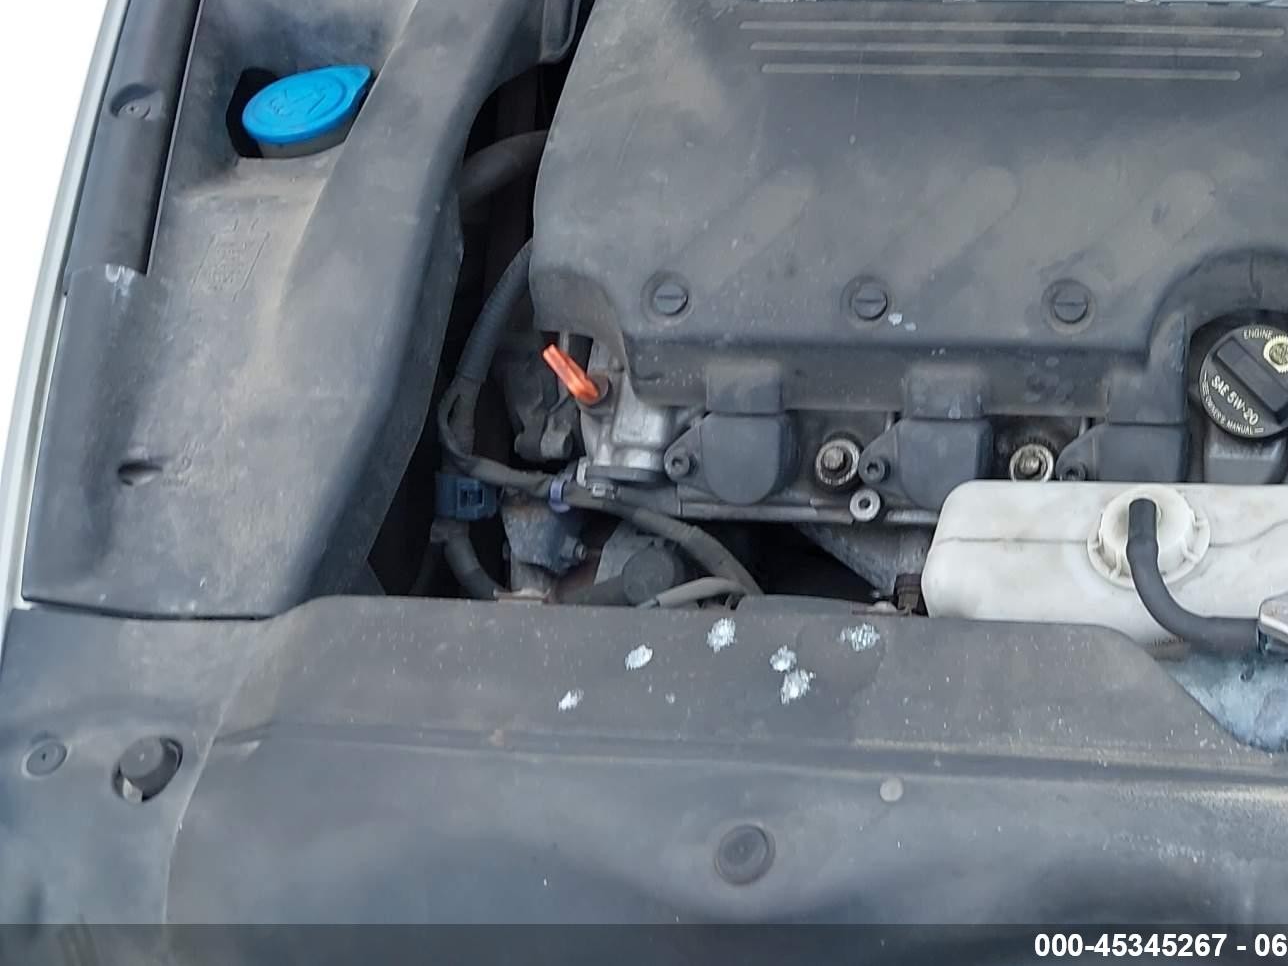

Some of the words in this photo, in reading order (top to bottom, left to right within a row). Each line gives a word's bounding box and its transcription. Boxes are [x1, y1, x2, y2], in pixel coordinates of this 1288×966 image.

[1243, 328, 1274, 340] ENGINE
[1211, 375, 1231, 397] SAE
[1227, 391, 1260, 426] 5W-20
[1226, 419, 1254, 435] MANUAL
